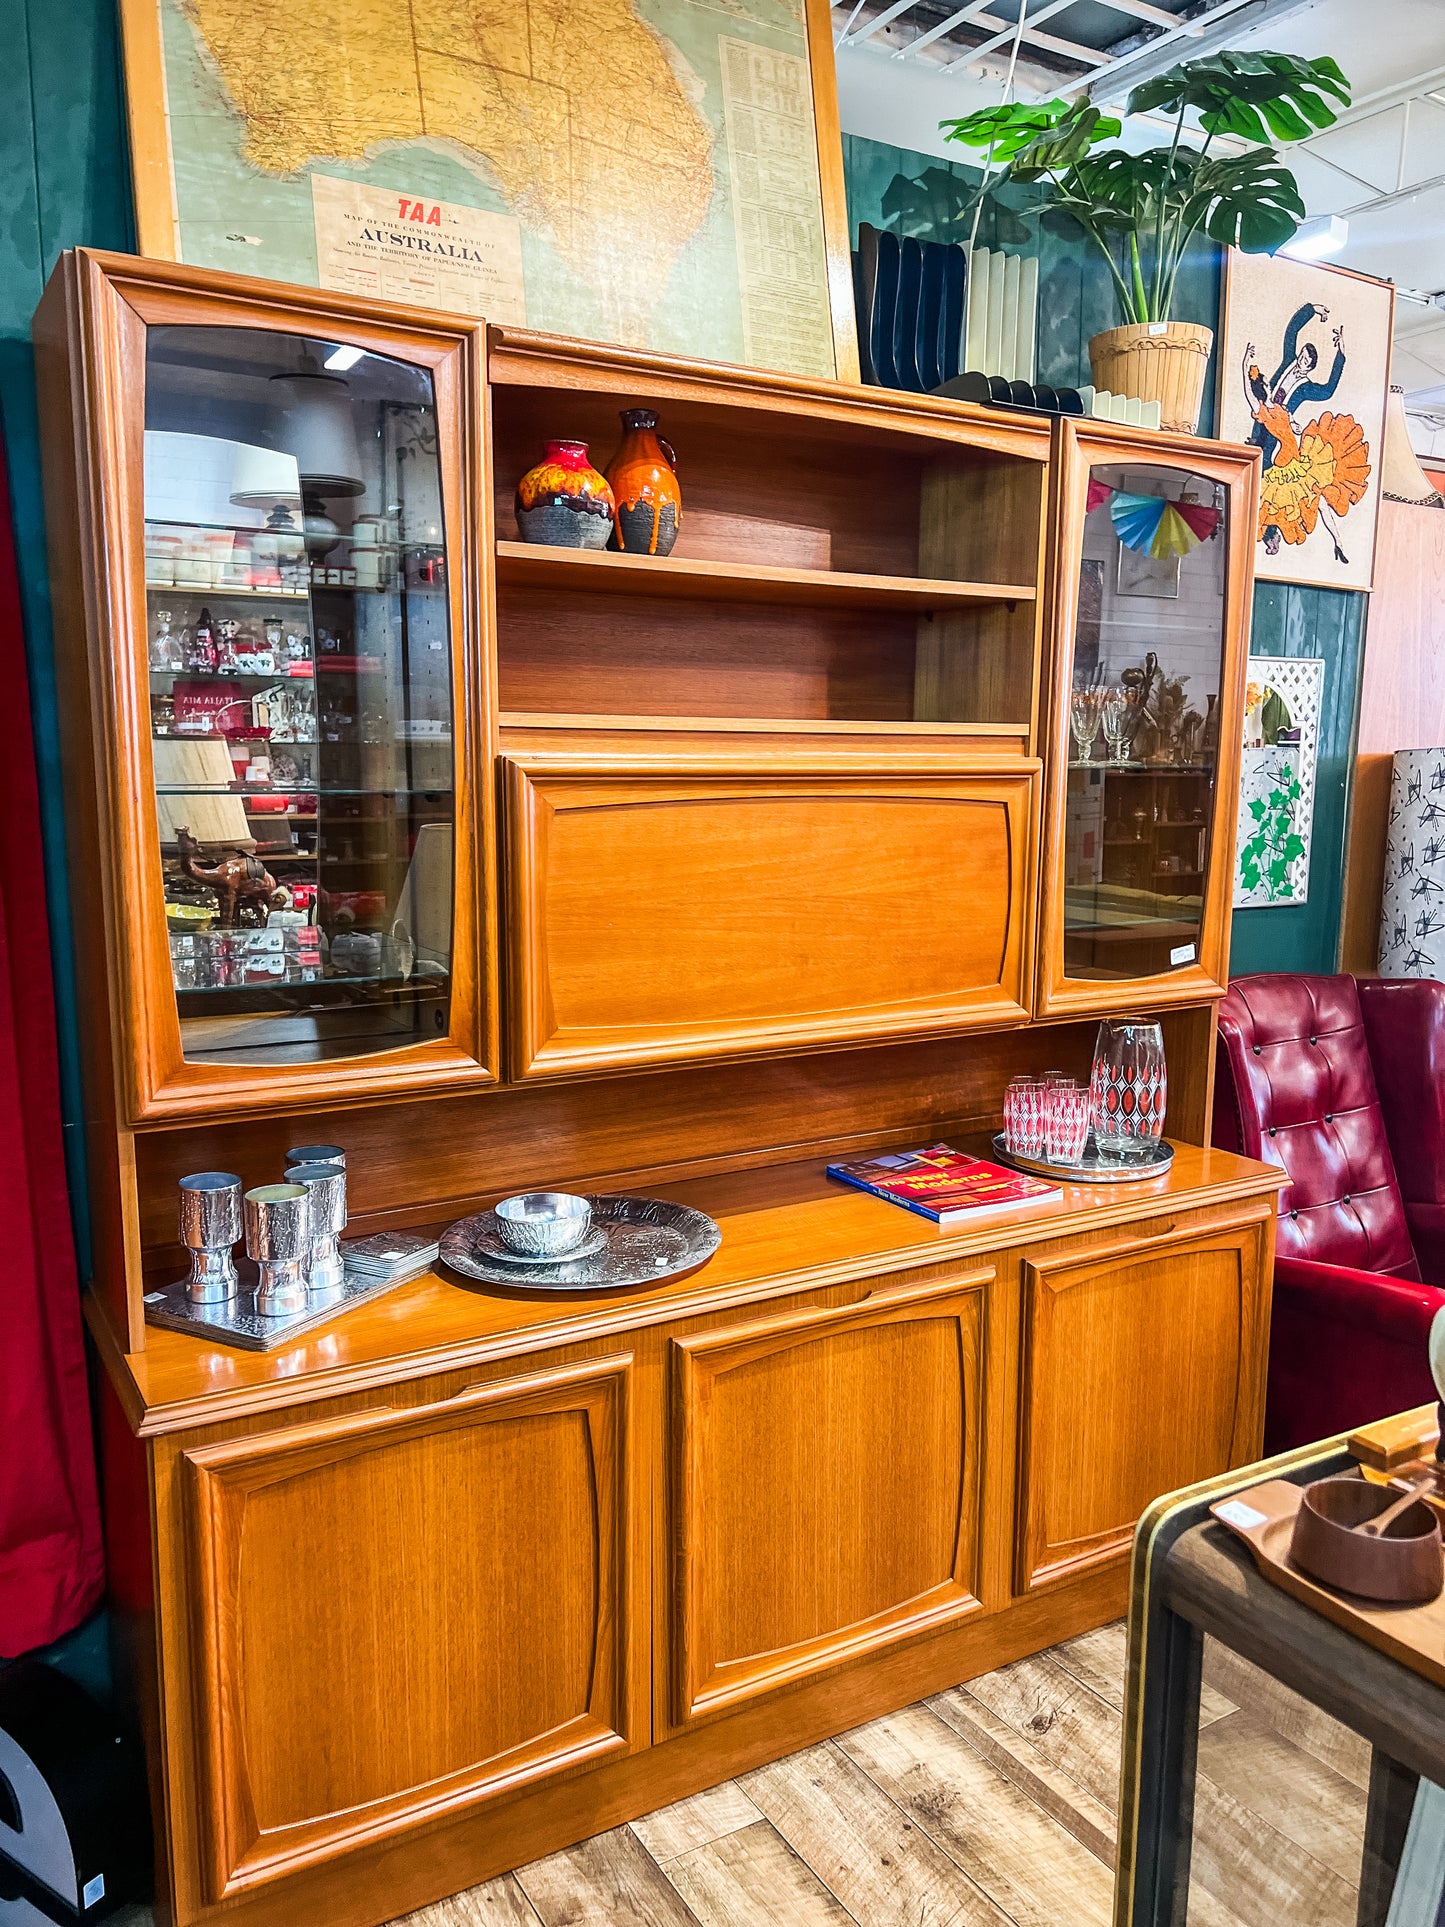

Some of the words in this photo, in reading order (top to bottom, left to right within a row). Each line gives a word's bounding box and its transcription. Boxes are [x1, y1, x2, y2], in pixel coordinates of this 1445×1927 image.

[398, 198, 441, 227] TAA
[344, 213, 363, 222] MAP
[382, 221, 400, 229] THE
[402, 225, 481, 246] COMMONWEALTH
[346, 240, 361, 248] AND
[381, 247, 418, 259] TERRITORY
[473, 265, 498, 275] GUINEA
[359, 227, 484, 263] AUSTRALIA
[879, 1179, 906, 1188] The
[903, 1172, 950, 1183] New
[907, 1172, 993, 1191] Moderns
[878, 1187, 889, 1198] New
[889, 1193, 911, 1208] Moderns
